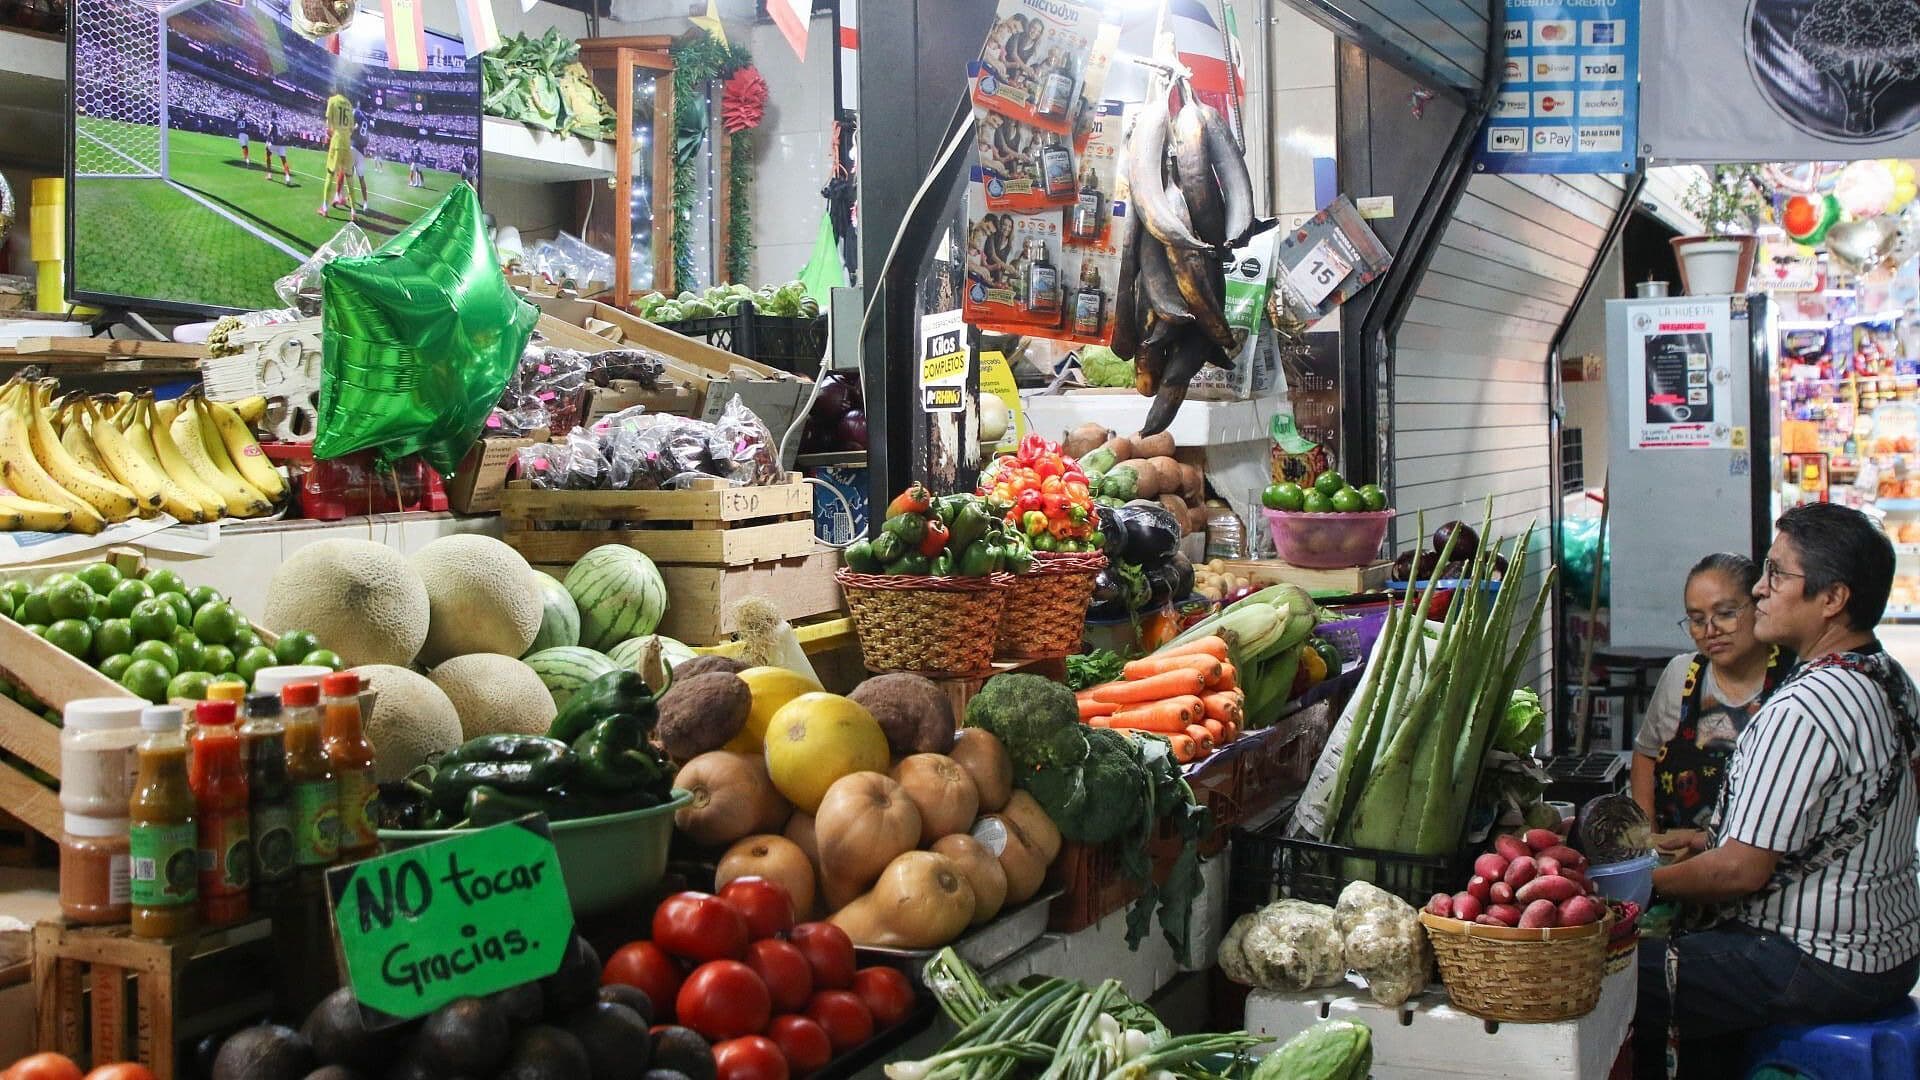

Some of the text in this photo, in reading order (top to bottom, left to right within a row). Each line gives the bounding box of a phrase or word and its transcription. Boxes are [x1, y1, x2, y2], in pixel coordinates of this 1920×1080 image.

[338, 106, 349, 127] 16
[360, 120, 368, 137] 8
[1550, 132, 1571, 147] Pay
[1503, 135, 1520, 146] Pay
[1310, 260, 1335, 285] 15
[932, 335, 956, 357] Kilos
[923, 355, 965, 380] COMPLETOS
[355, 852, 546, 934] NO tocar
[381, 924, 540, 996] Gracias.
